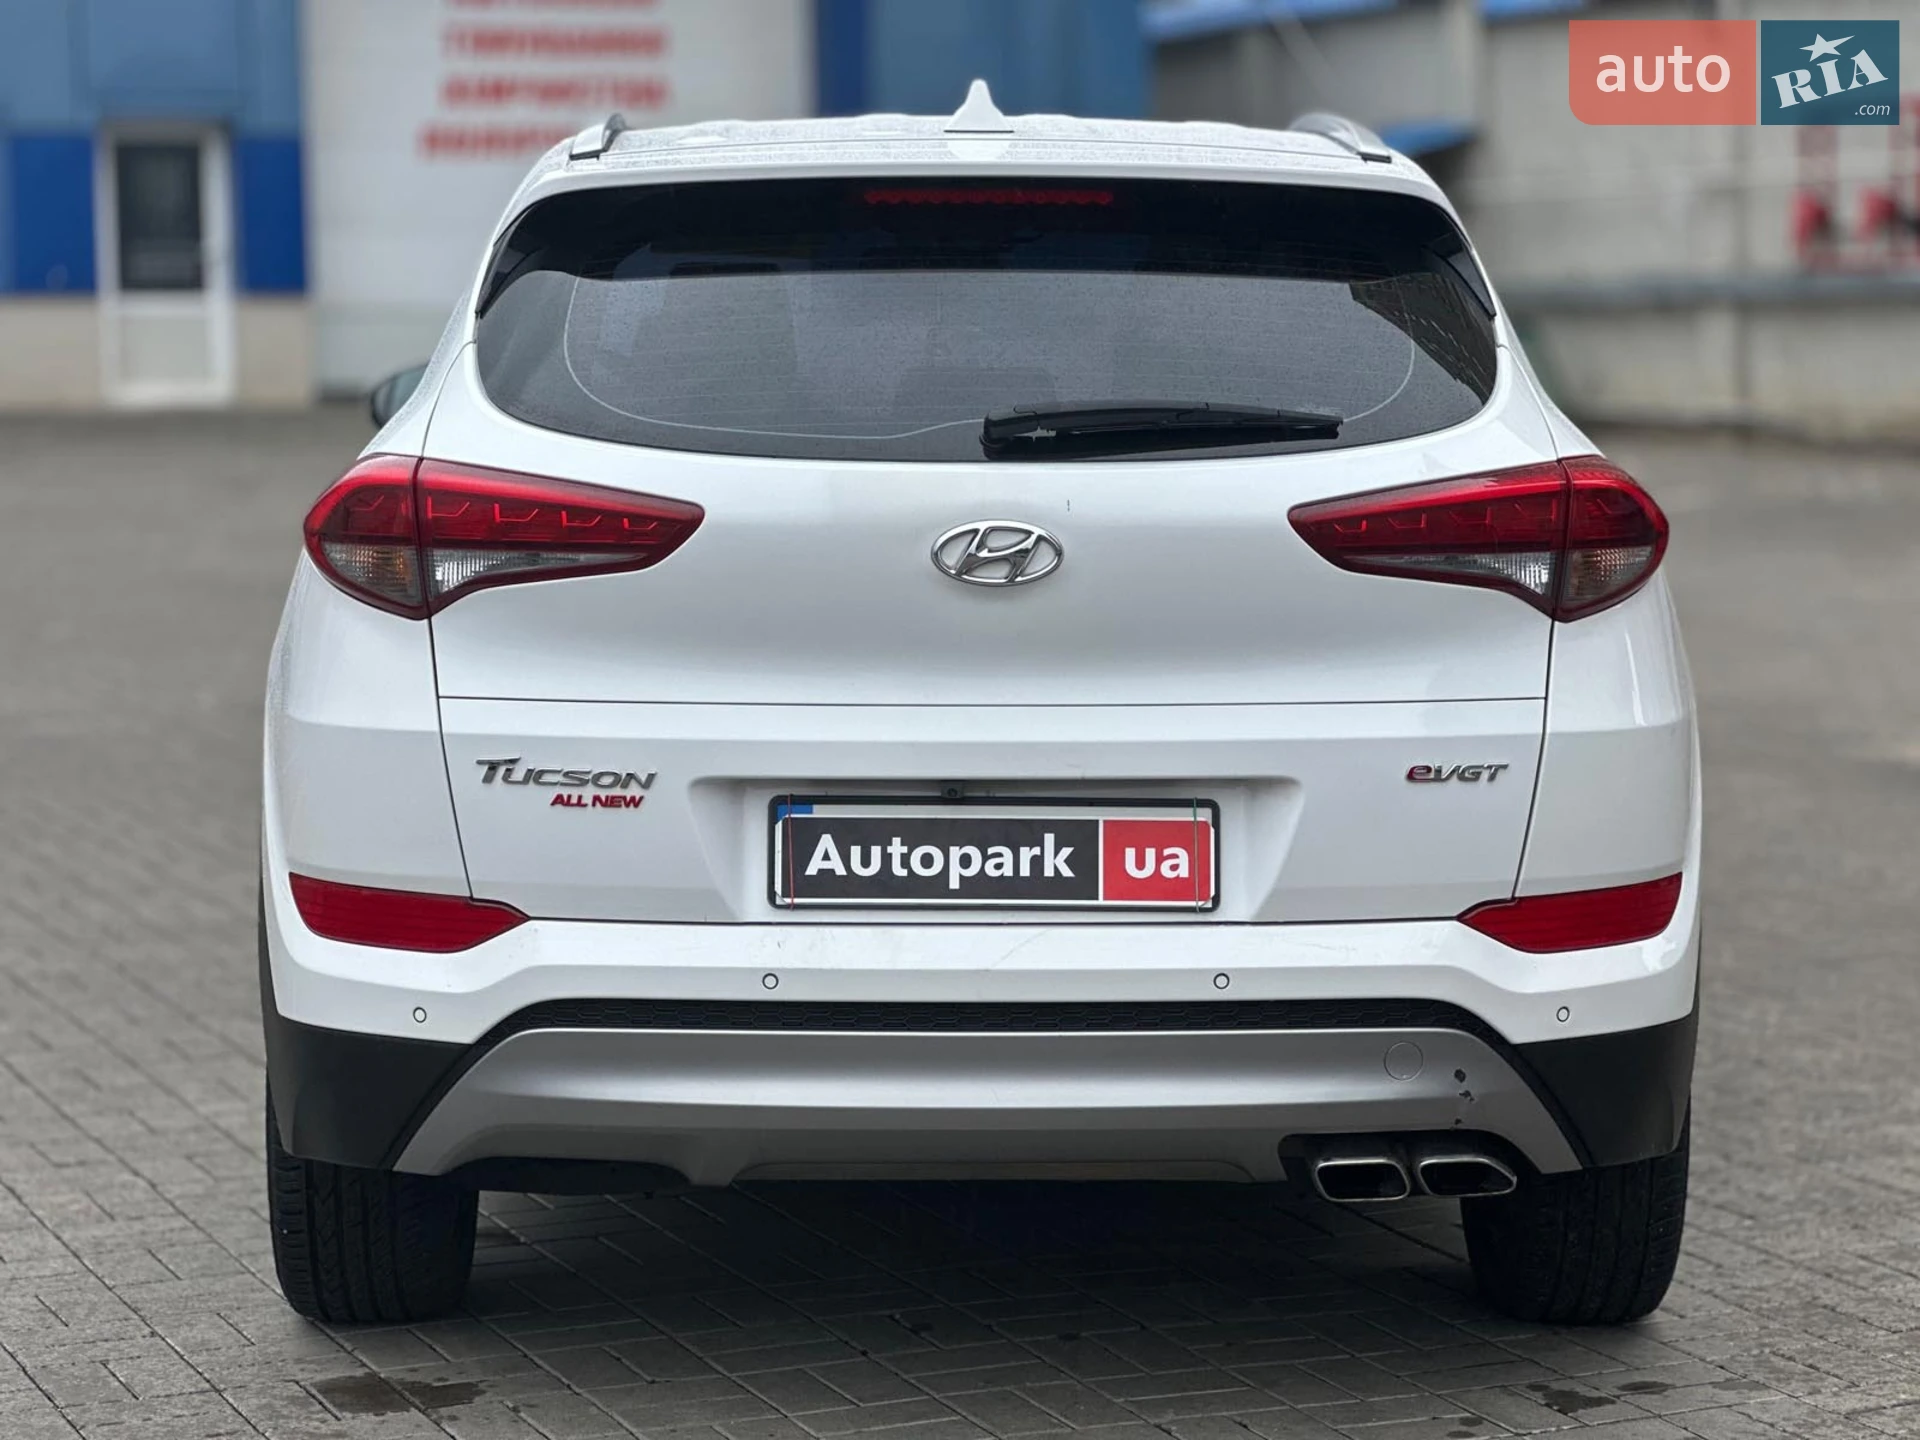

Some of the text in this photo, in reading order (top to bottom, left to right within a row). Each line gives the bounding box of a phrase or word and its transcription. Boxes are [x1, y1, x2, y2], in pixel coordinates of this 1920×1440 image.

[550, 793, 644, 809] ALL NEW
[804, 833, 1190, 890] Autopark ua
